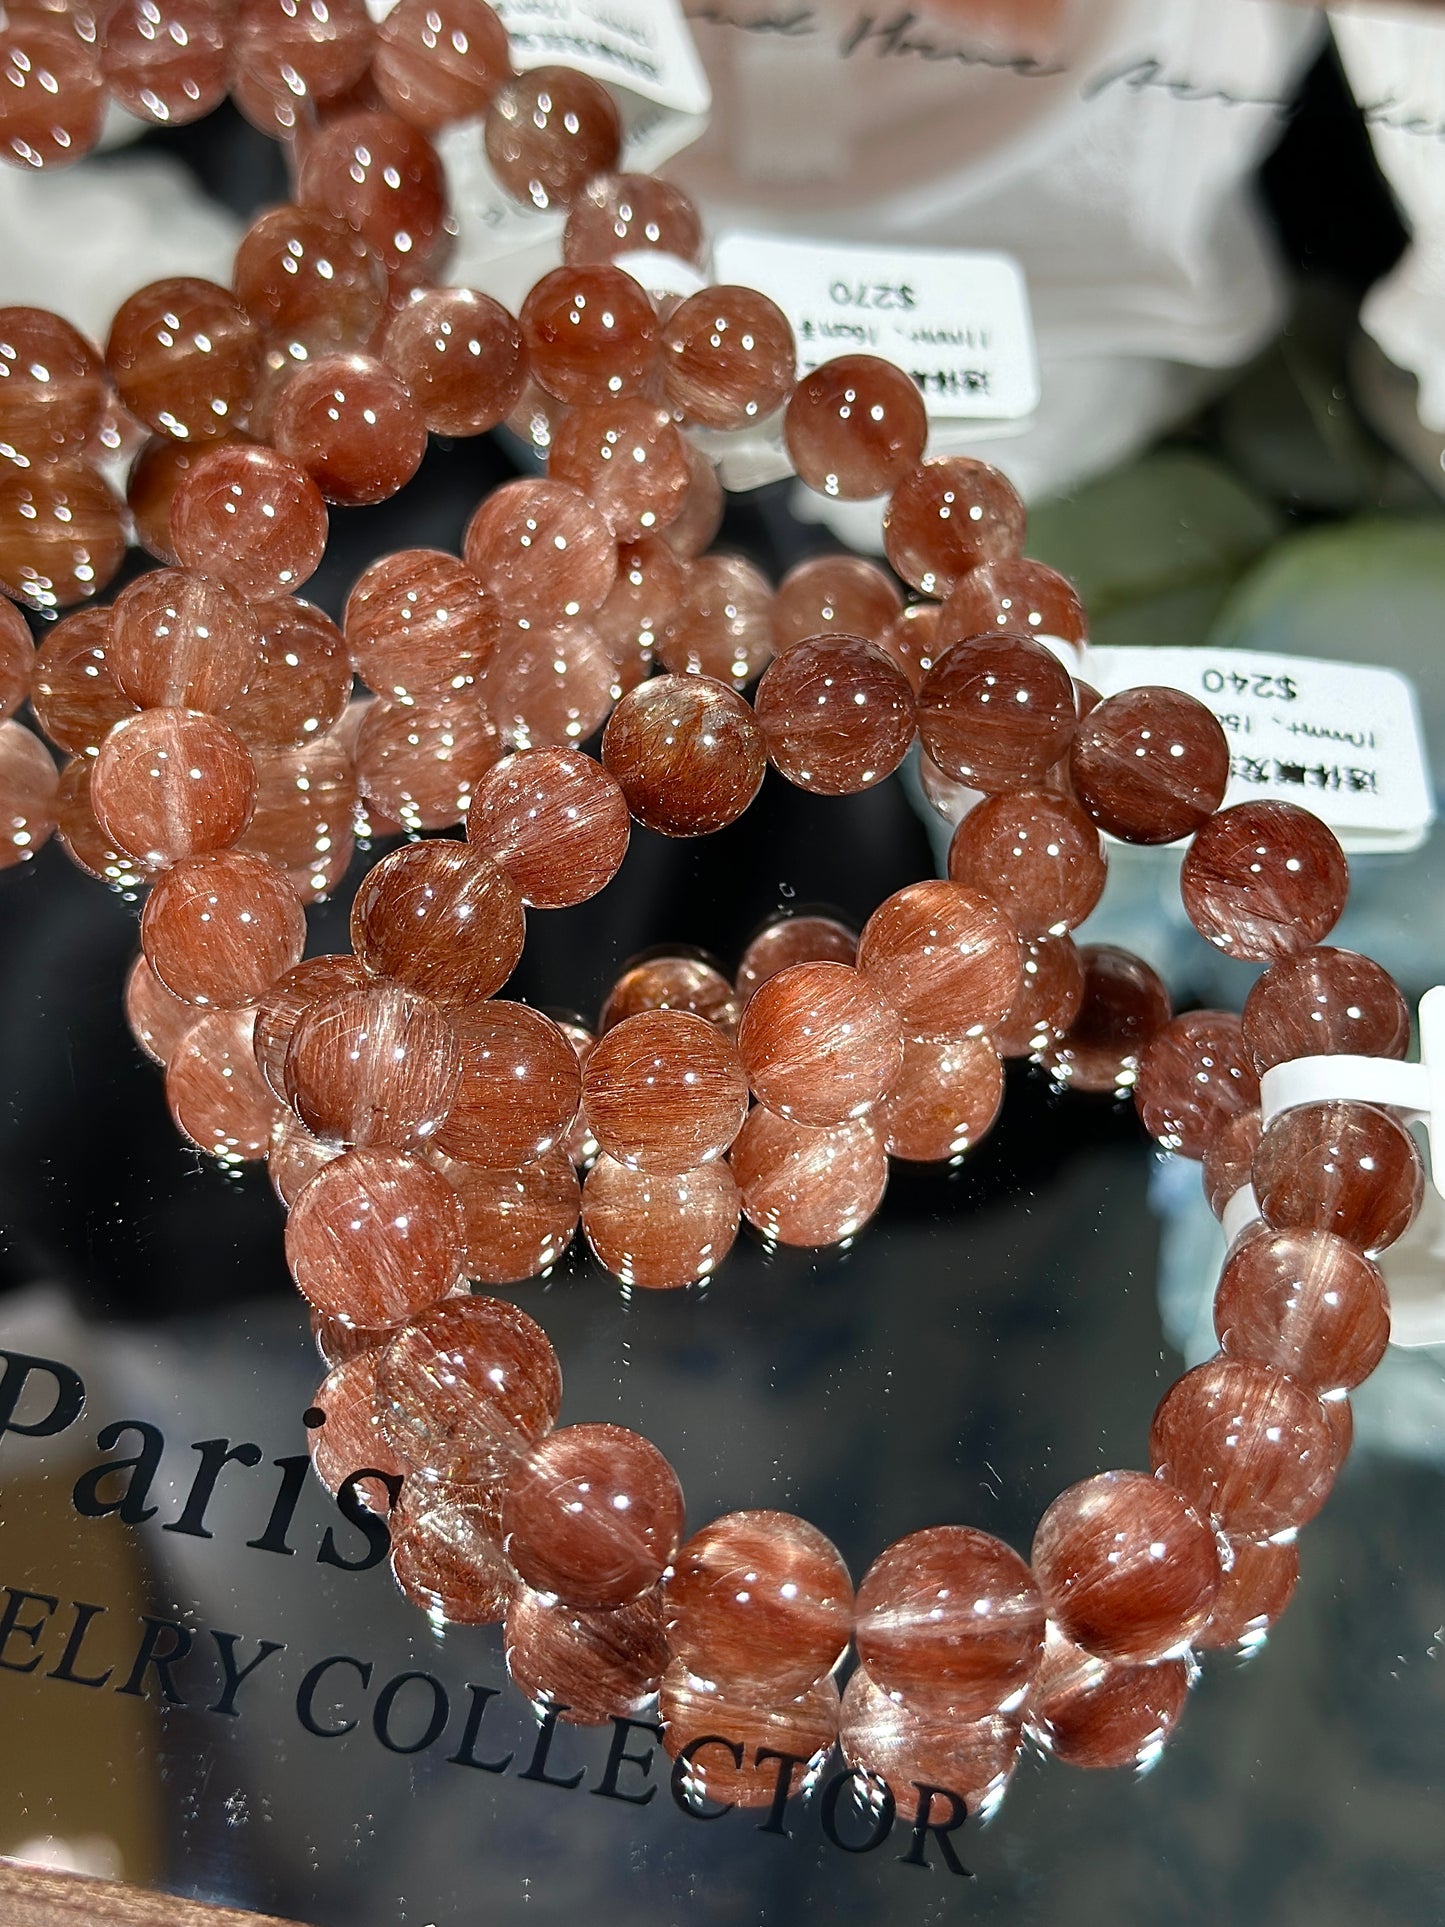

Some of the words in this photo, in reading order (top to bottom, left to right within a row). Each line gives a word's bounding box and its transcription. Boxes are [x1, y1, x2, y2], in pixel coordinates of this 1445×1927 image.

[829, 281, 915, 310] $270
[1202, 669, 1297, 702] $240
[0, 1349, 404, 1571] Paris
[296, 1656, 974, 1876] COLLECTOR
